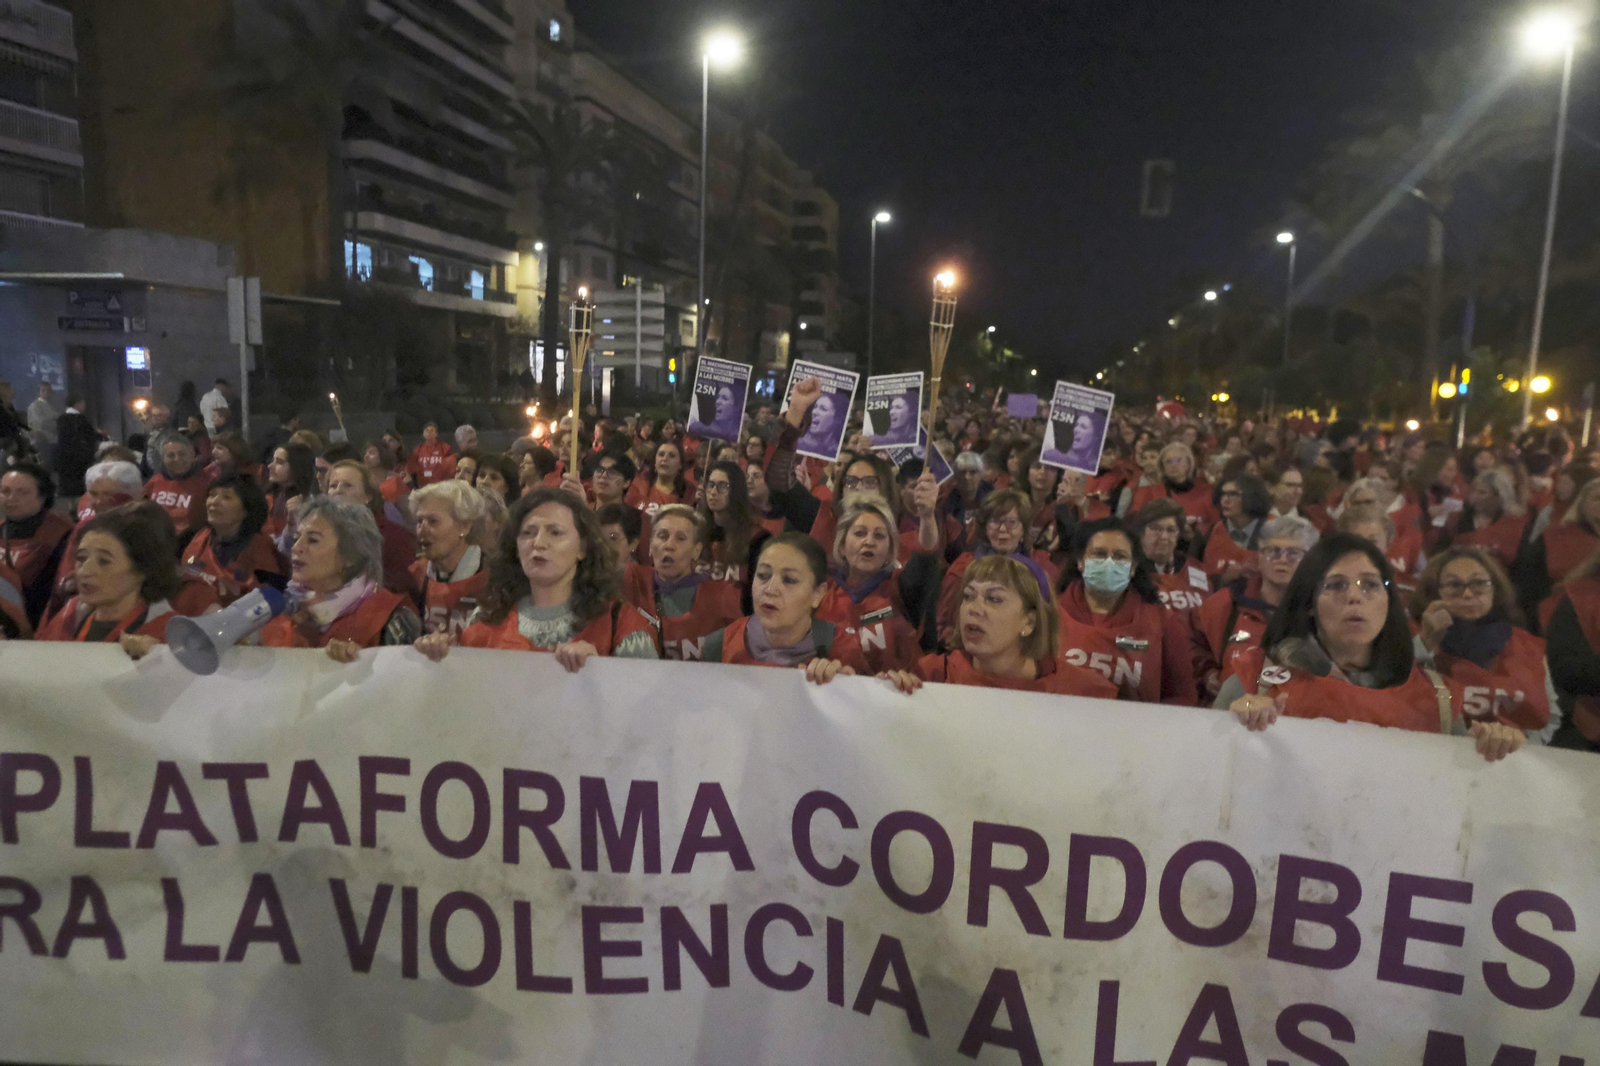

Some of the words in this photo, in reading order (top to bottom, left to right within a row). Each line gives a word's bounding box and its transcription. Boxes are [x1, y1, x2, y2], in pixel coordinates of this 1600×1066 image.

[713, 375, 735, 384] MUJERES
[804, 367, 836, 379] MACHISMO
[696, 383, 716, 396] 25N
[867, 400, 889, 410] 25N
[1052, 411, 1075, 424] 25N
[1159, 590, 1203, 610] 25N
[1065, 648, 1142, 689] 25N
[0, 753, 755, 873] PLATAFORMA
[161, 873, 301, 965] LA
[328, 878, 931, 1040] VIOLENCIA
[957, 968, 1043, 1066] A
[1093, 981, 1356, 1066] LAS
